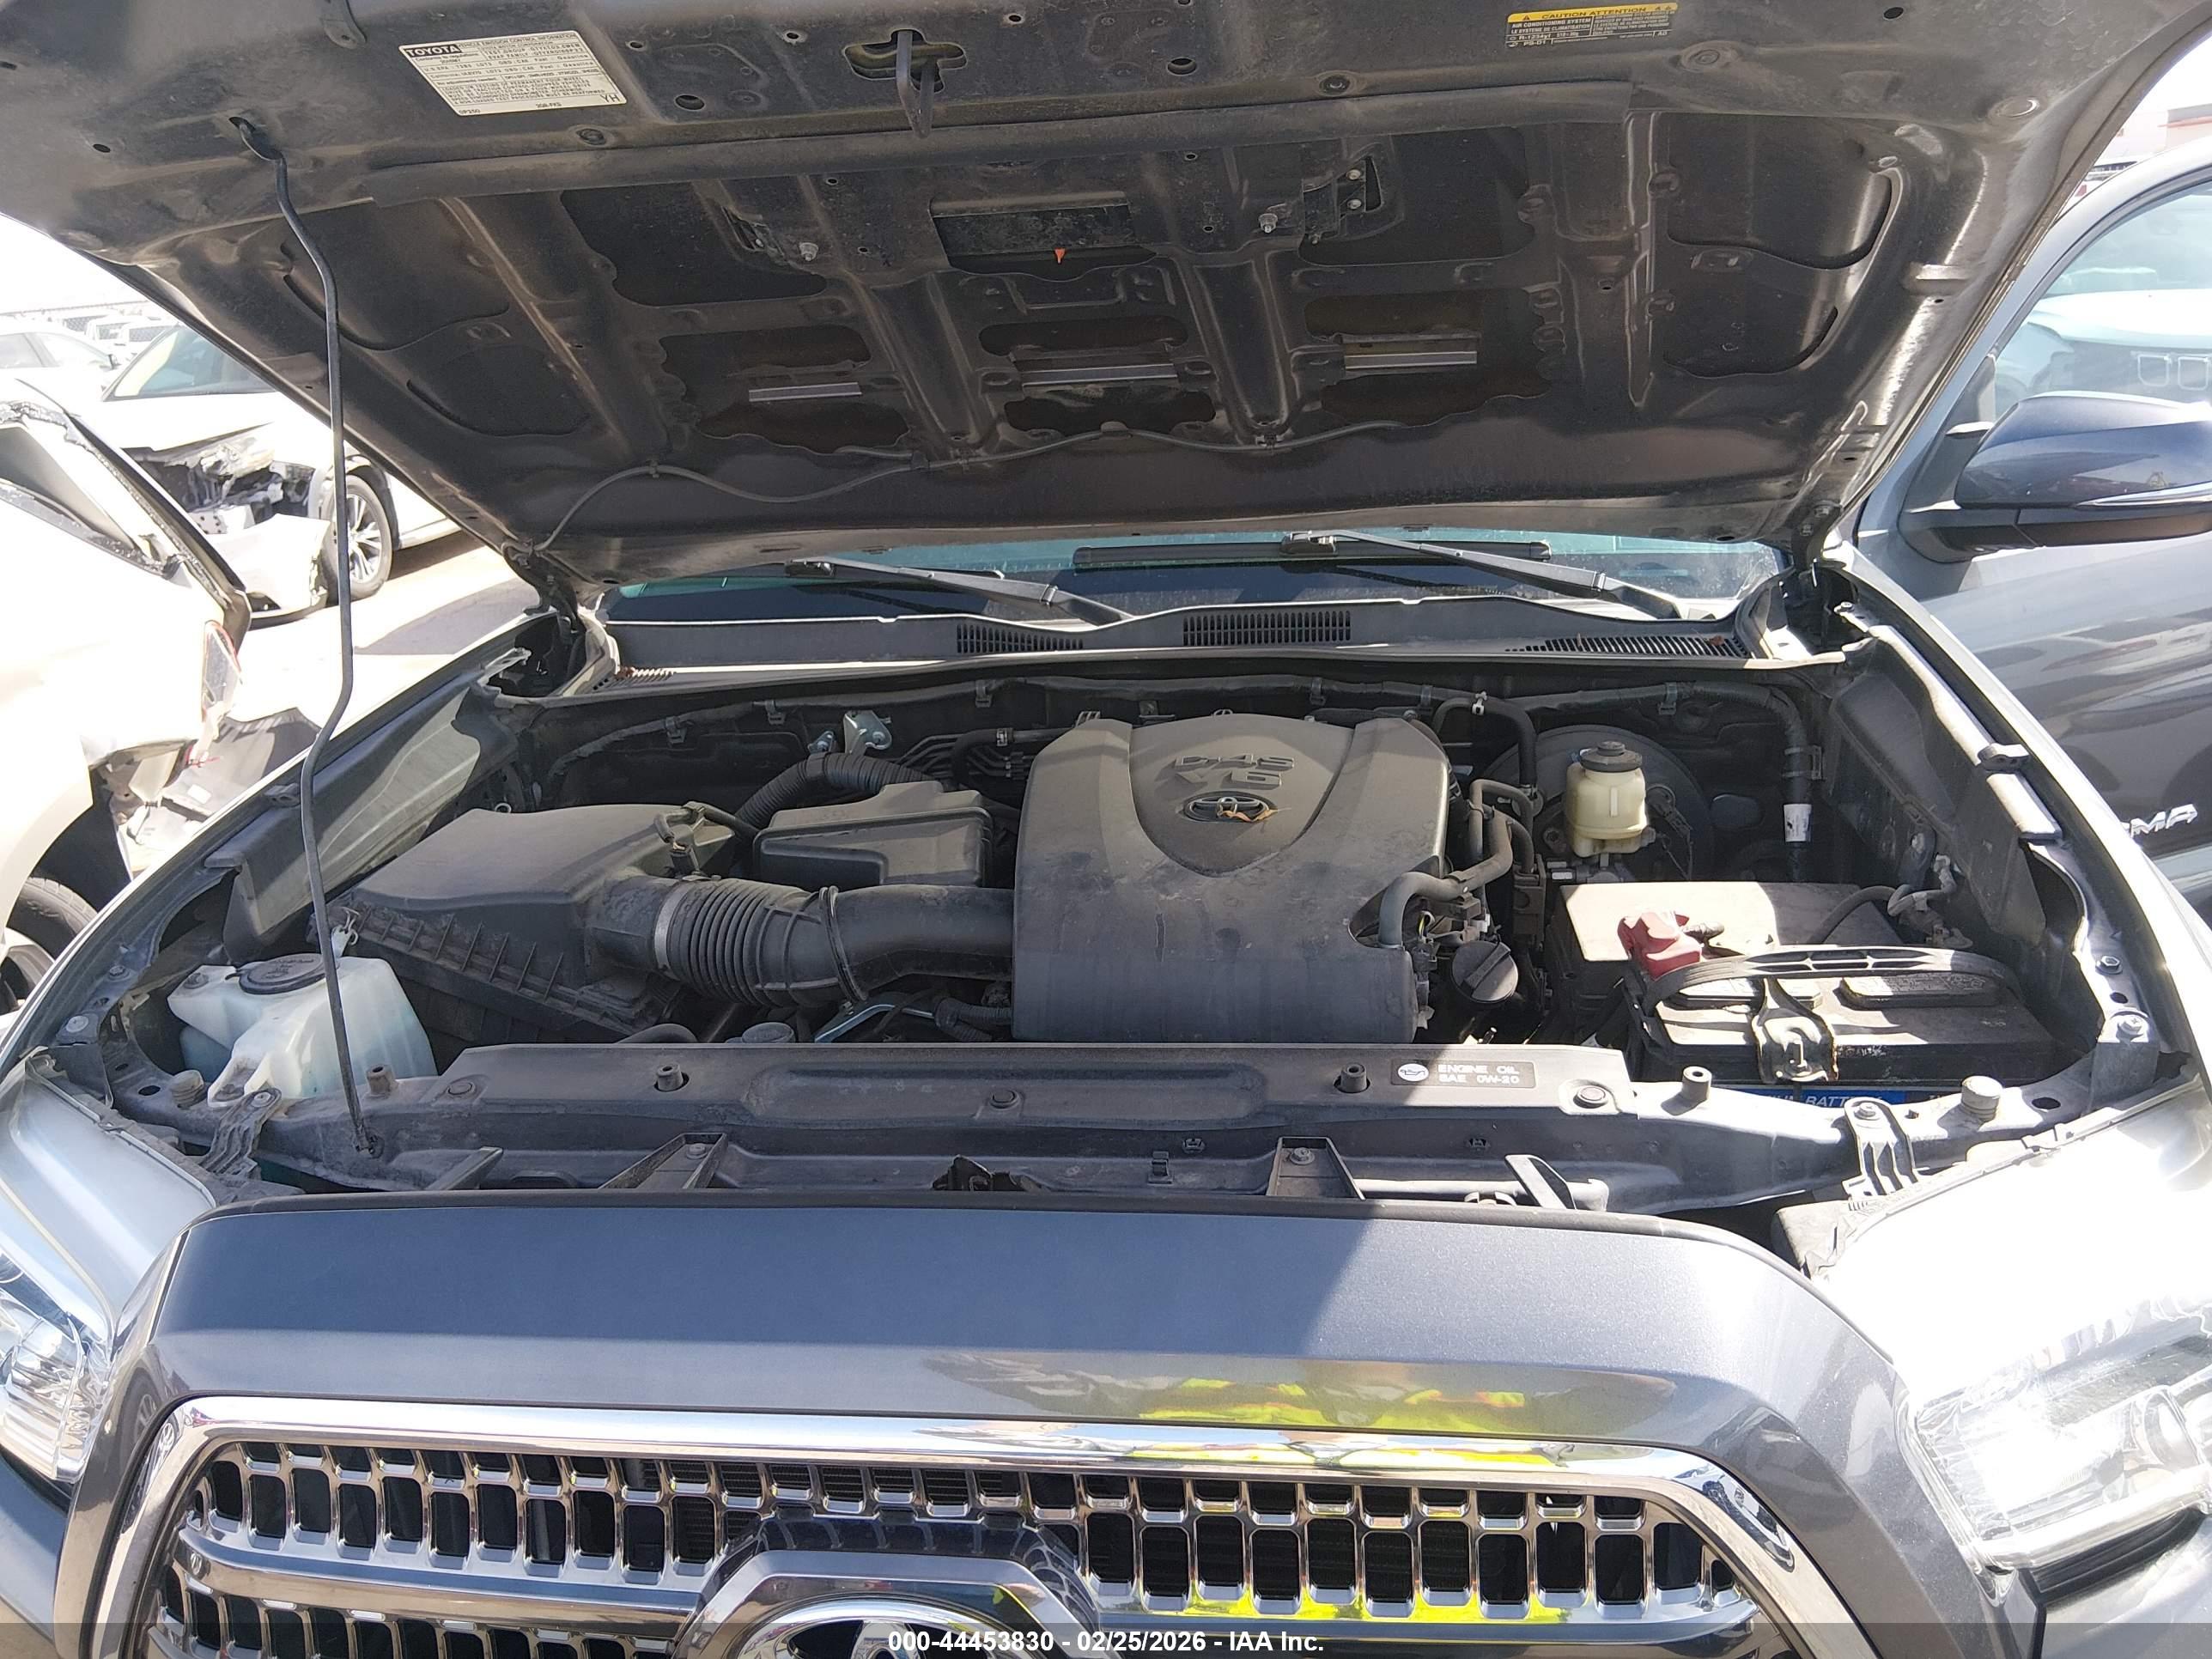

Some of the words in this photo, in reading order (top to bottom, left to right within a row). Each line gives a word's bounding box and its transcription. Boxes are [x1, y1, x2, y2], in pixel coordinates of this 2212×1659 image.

[1589, 7, 1646, 15] ATTENTION
[406, 46, 461, 57] TOYOTA
[1177, 769, 1282, 790] V6
[1437, 1064, 1488, 1073] ENGINE
[1497, 1066, 1519, 1074] OIL
[1438, 1074, 1467, 1083] SAE
[1477, 1075, 1520, 1084] 0W-20
